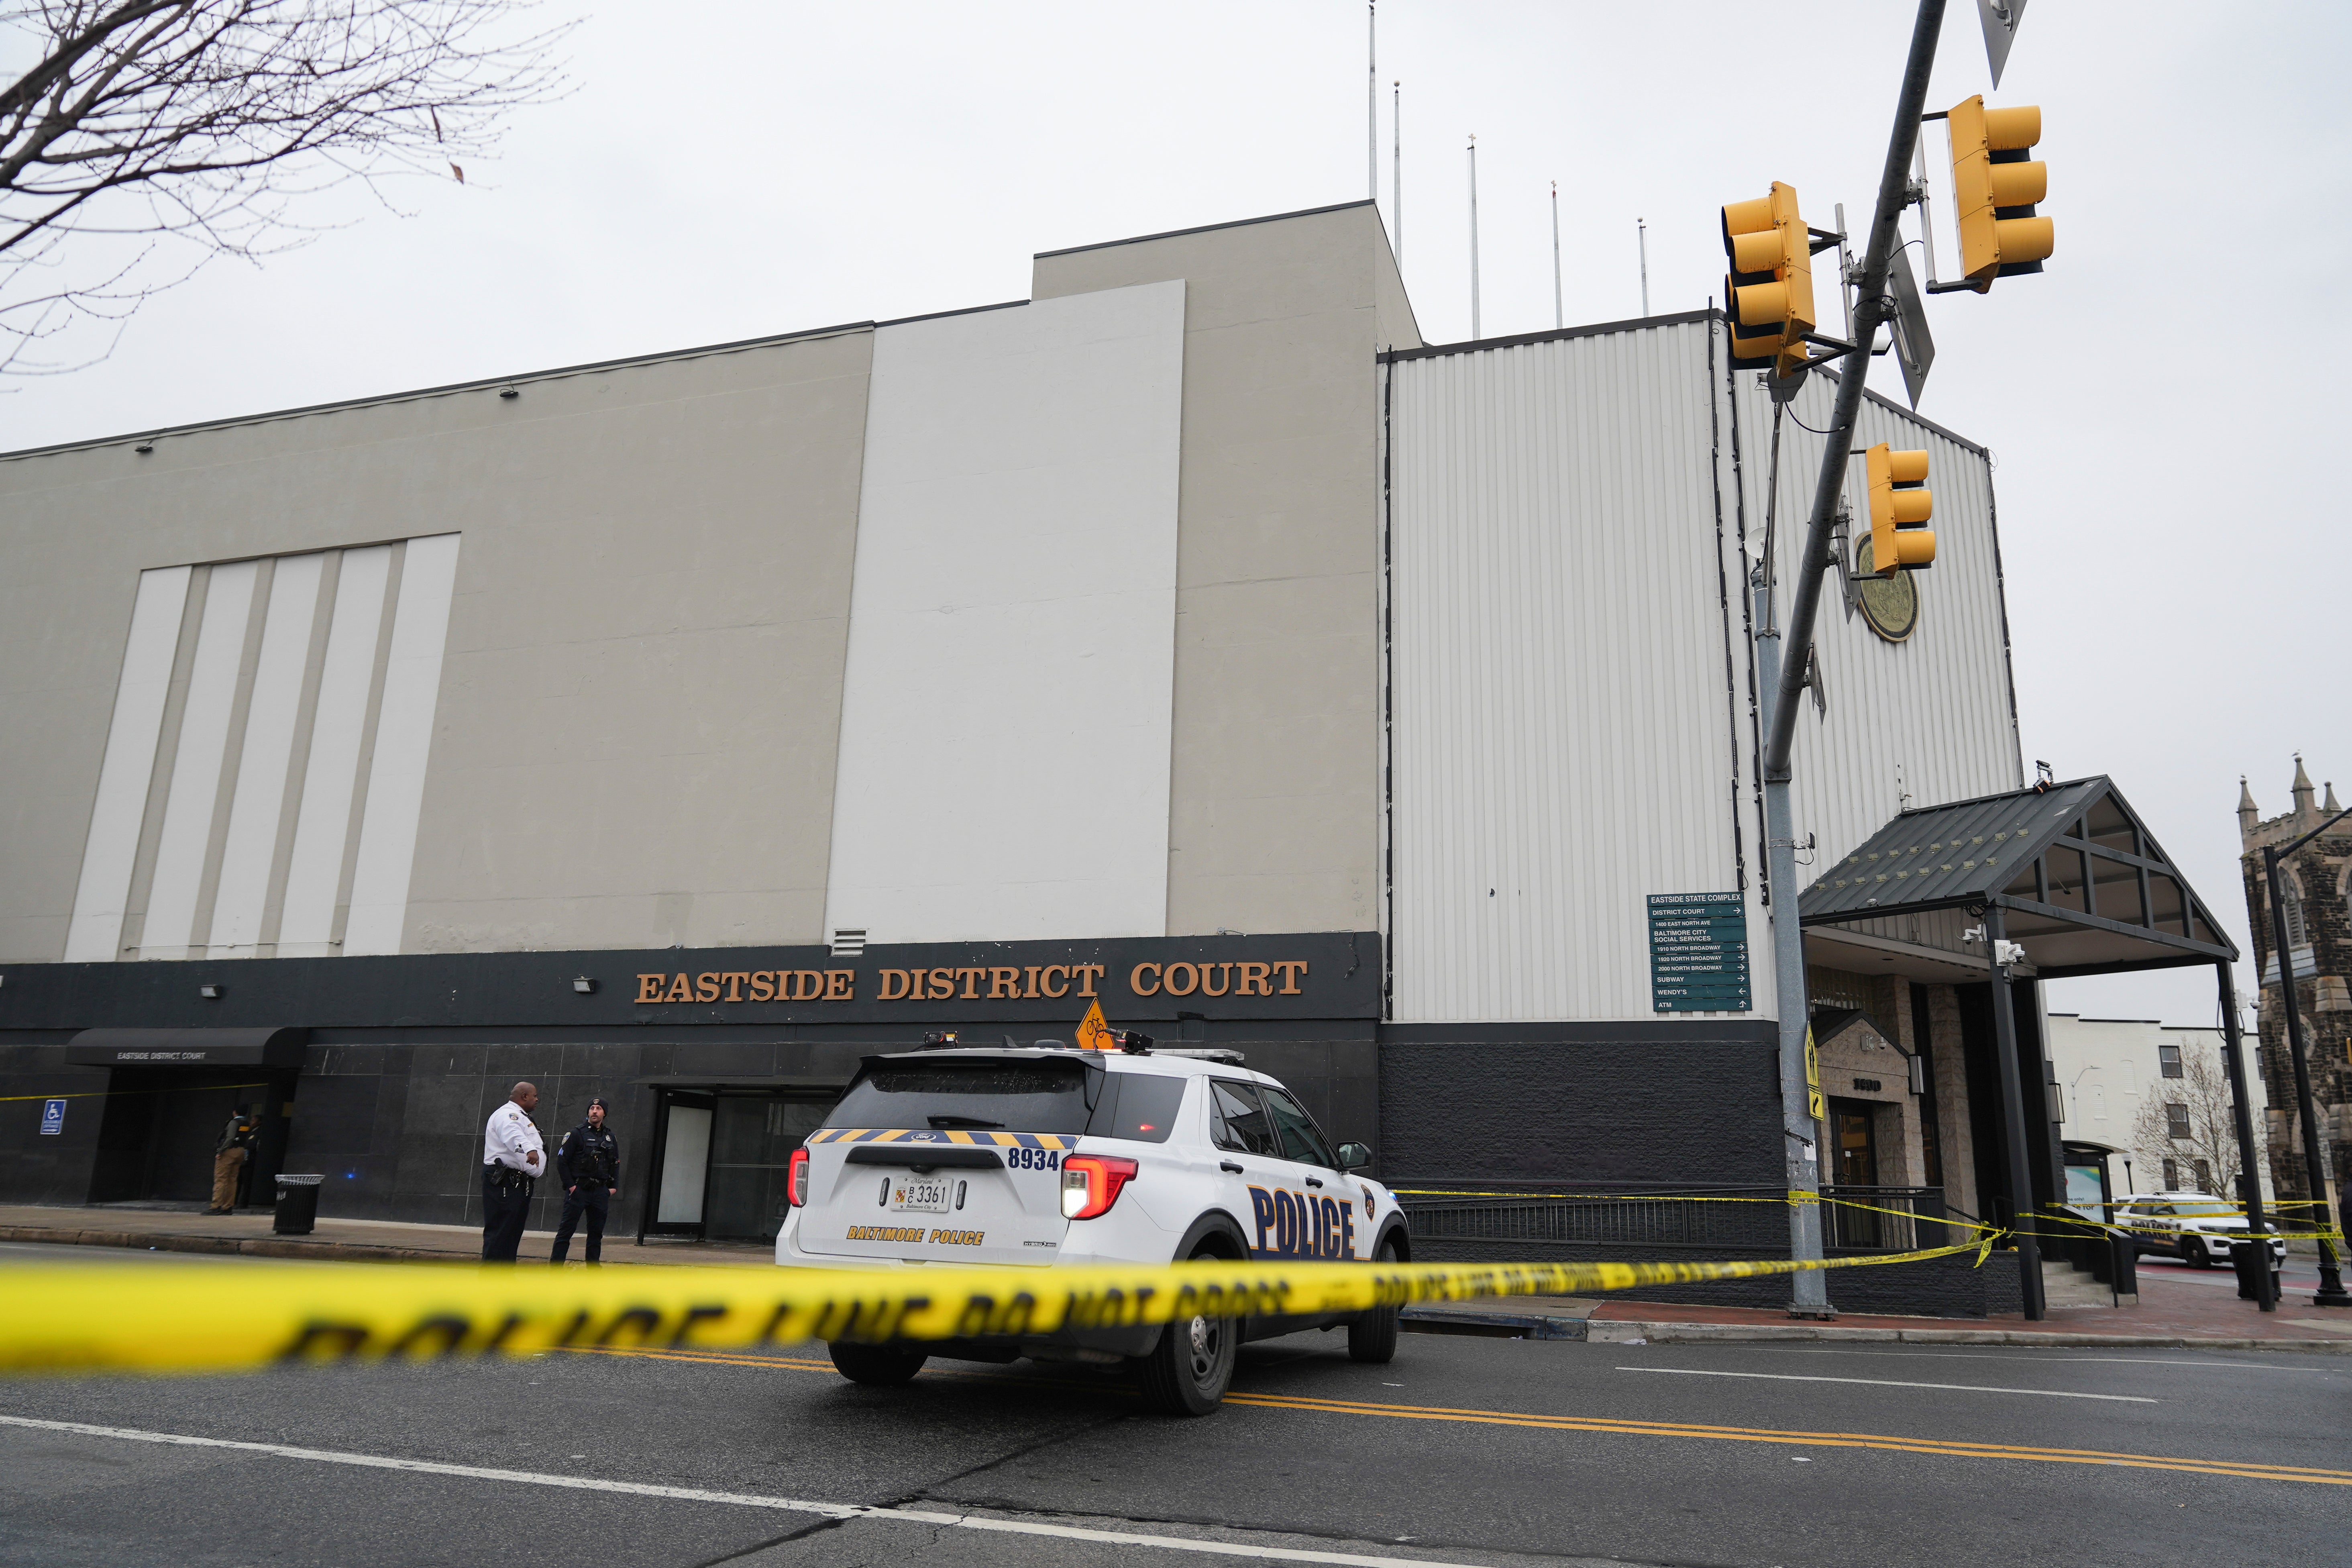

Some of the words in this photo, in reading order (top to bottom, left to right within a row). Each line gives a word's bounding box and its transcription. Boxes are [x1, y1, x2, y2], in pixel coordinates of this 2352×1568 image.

[634, 969, 855, 1003] EASTSIDE
[876, 965, 1105, 1000] DISTRICT
[1130, 961, 1308, 996] COURT
[1853, 1078, 1882, 1091] 1400
[1008, 1148, 1059, 1171] 8934
[917, 1185, 946, 1203] 3361
[1246, 1184, 1355, 1259] POLICE
[846, 1226, 925, 1242] BALTIMORE
[928, 1229, 985, 1246] POLICE
